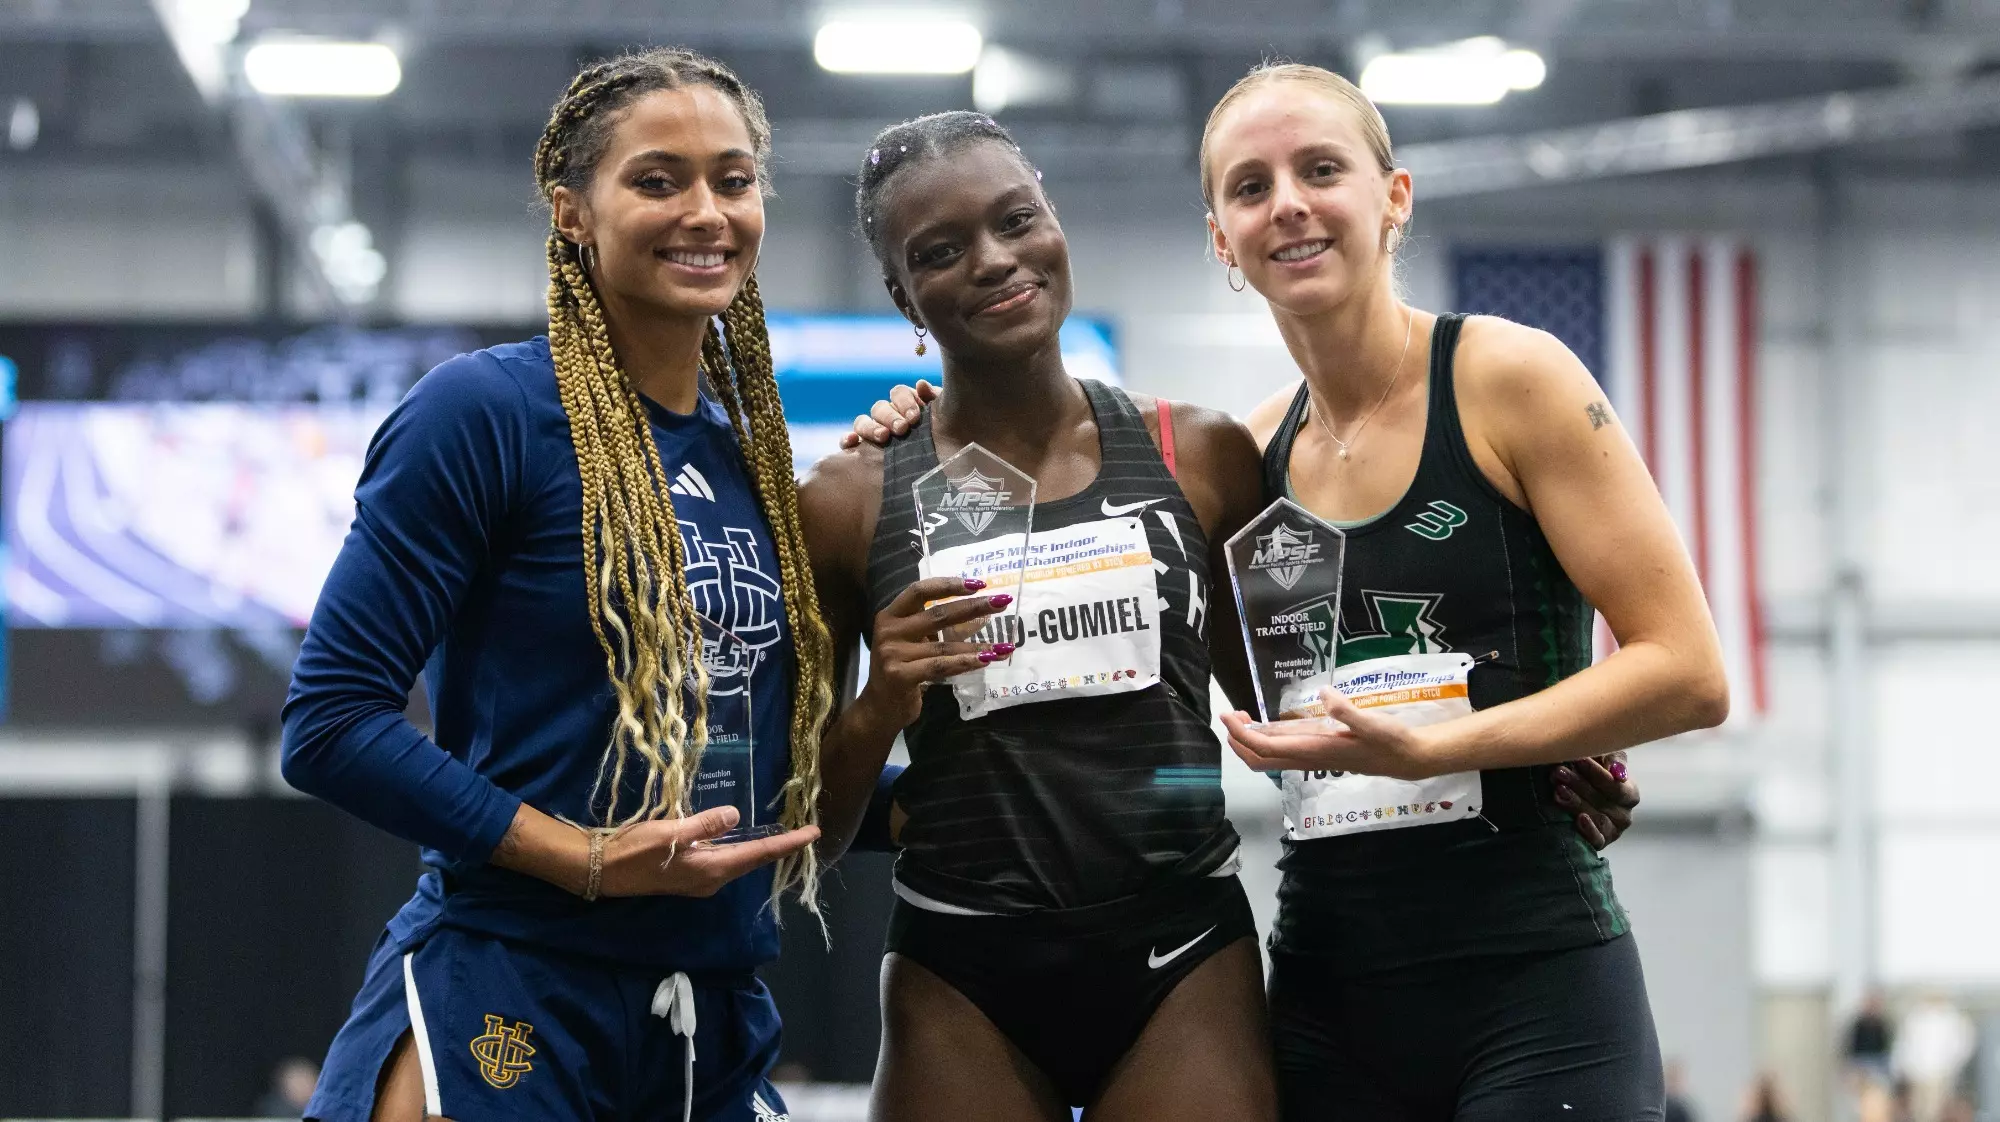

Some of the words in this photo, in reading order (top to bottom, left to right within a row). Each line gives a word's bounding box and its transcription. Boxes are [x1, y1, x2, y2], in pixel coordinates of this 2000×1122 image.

[940, 492, 1012, 507] MPSF
[966, 549, 1004, 565] 2025
[1051, 535, 1098, 551] Indoor
[1251, 543, 1321, 565] MPSF
[988, 559, 1023, 574] Field
[1026, 542, 1137, 567] Championships
[1271, 612, 1310, 625] INDOOR
[1256, 625, 1288, 637] TRACK
[1290, 624, 1297, 634] &
[1300, 621, 1326, 633] FIELD
[1275, 658, 1313, 669] Pentathlon
[1275, 669, 1294, 679] Third
[1296, 668, 1315, 678] Place
[1351, 673, 1383, 687] MPSF
[1384, 671, 1428, 682] Indoor
[1379, 691, 1410, 703] POWERED
[1411, 689, 1420, 699] BY
[1422, 687, 1441, 699] STCU
[716, 733, 739, 744] FIELD
[698, 769, 731, 780] Pentathlon
[697, 781, 718, 791] Second
[719, 779, 736, 788] Place
